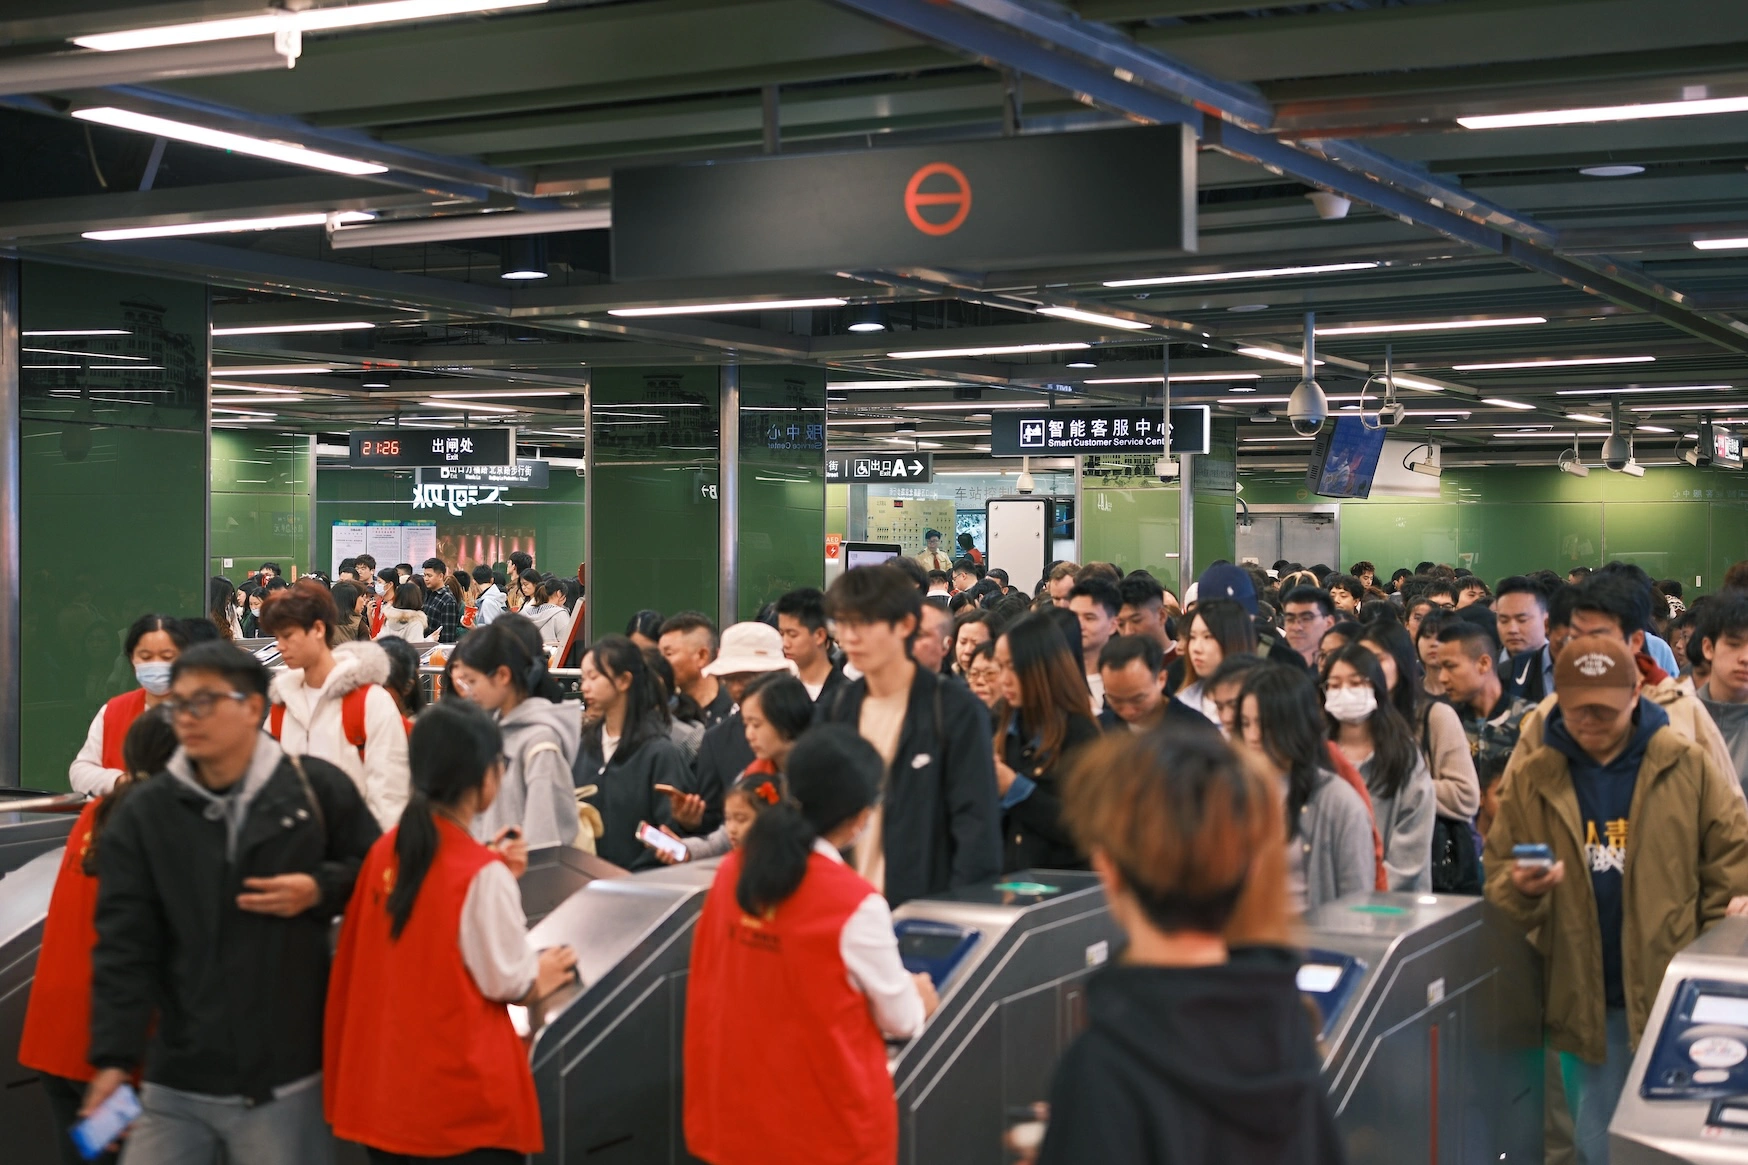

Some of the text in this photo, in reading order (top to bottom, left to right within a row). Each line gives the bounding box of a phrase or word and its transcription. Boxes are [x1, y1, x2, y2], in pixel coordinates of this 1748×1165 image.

[1048, 419, 1174, 438] 智能客服中心
[362, 441, 399, 455] 21:26
[432, 437, 474, 454] 出闸处
[1048, 437, 1173, 447] Smart Customer Service Centr
[826, 458, 908, 477] 街 出口 A
[955, 486, 1018, 500] 车站控制
